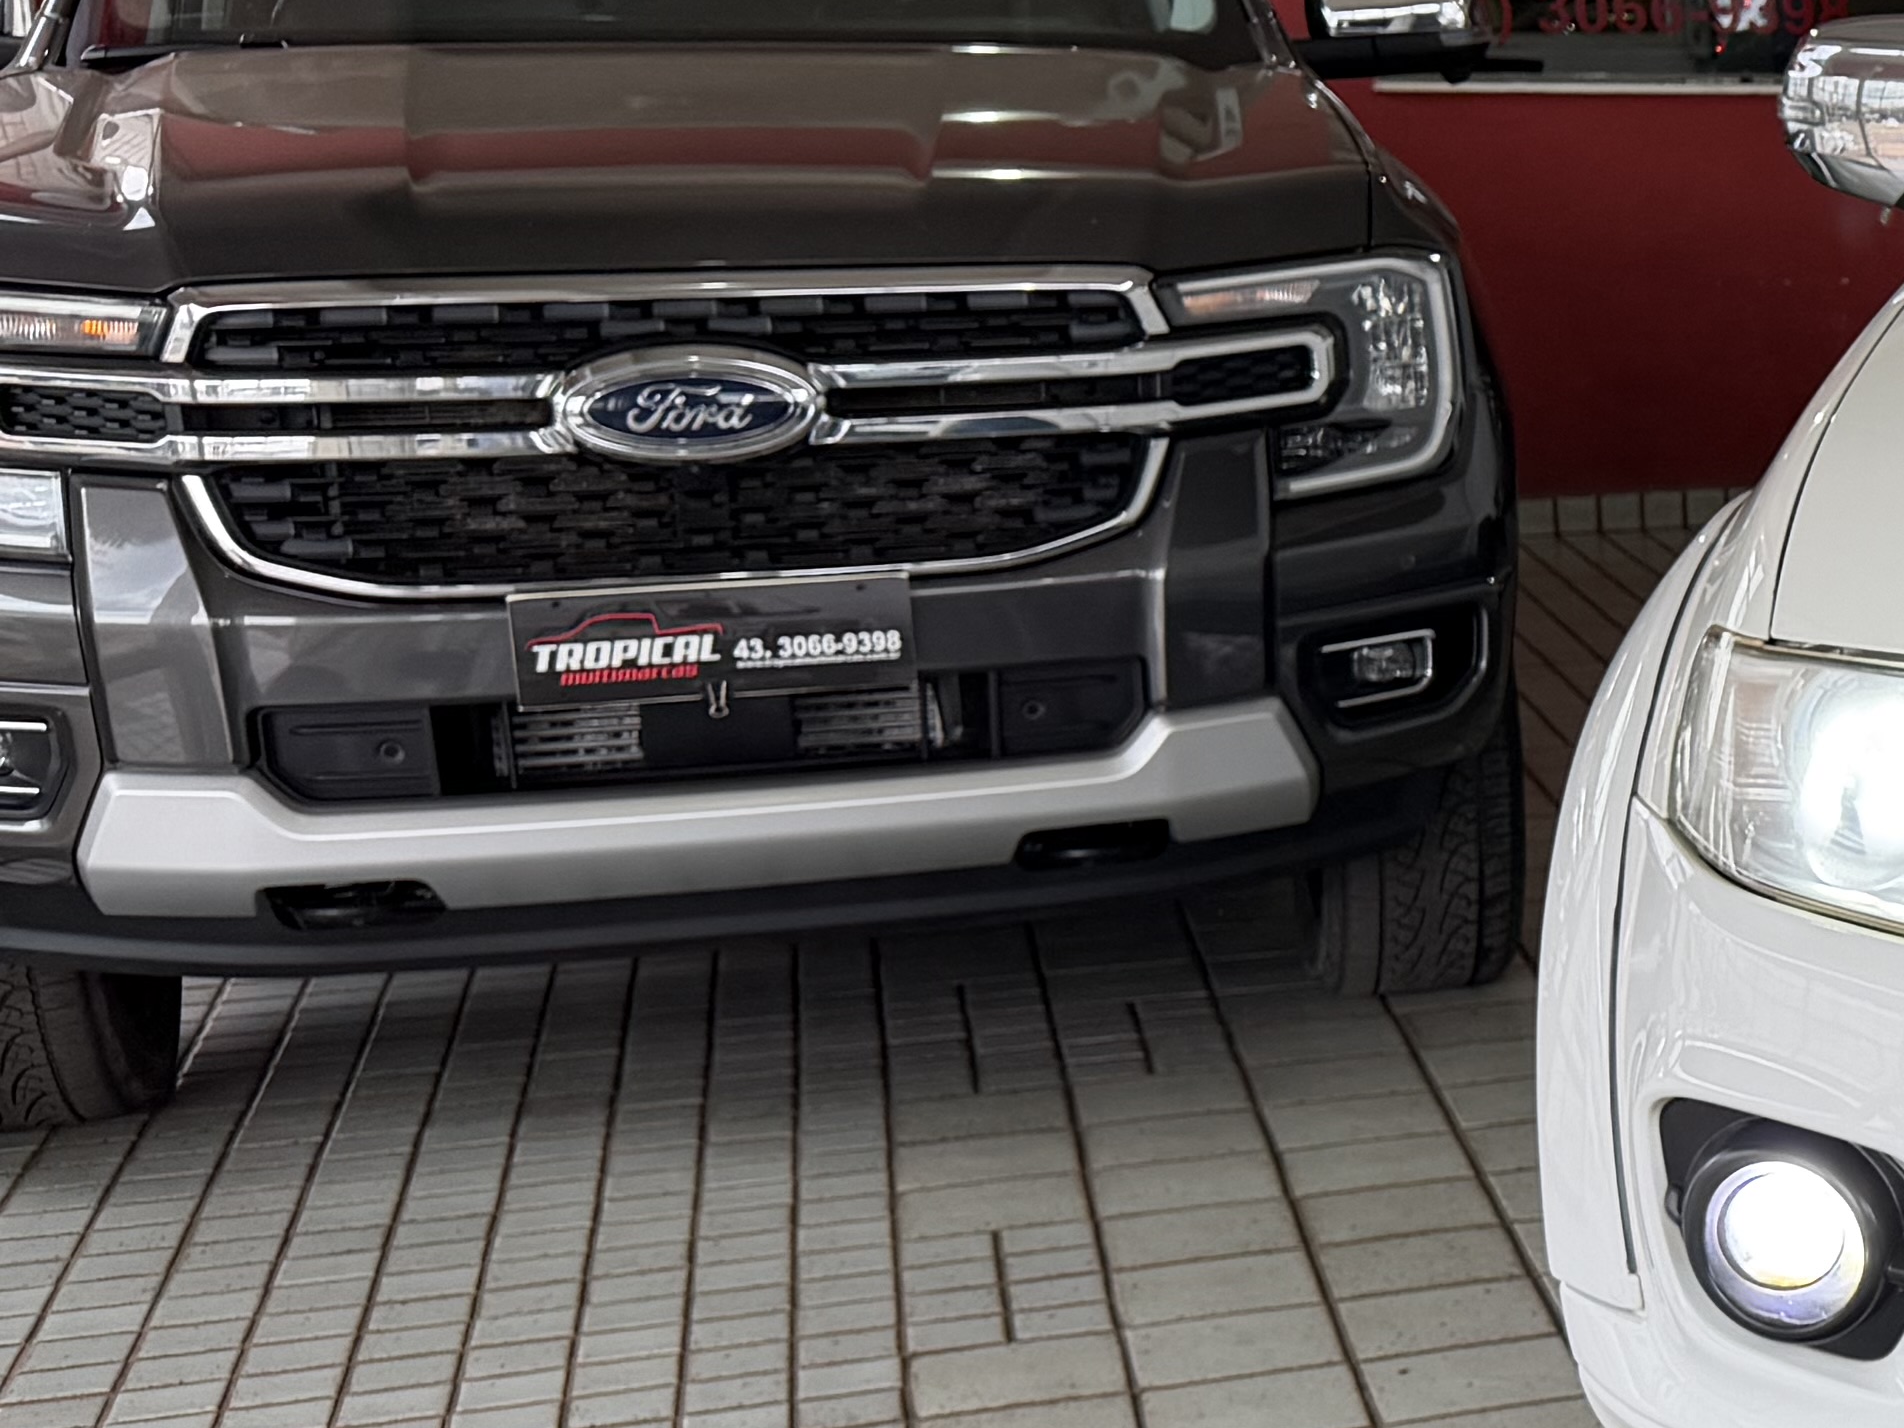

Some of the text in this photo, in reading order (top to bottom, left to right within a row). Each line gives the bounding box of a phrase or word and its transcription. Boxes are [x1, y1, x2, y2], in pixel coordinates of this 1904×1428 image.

[626, 383, 754, 433] Ford
[531, 634, 721, 673] TROPICAL
[733, 629, 903, 660] 43. 3066-9398
[559, 664, 700, 687] multimarcas
